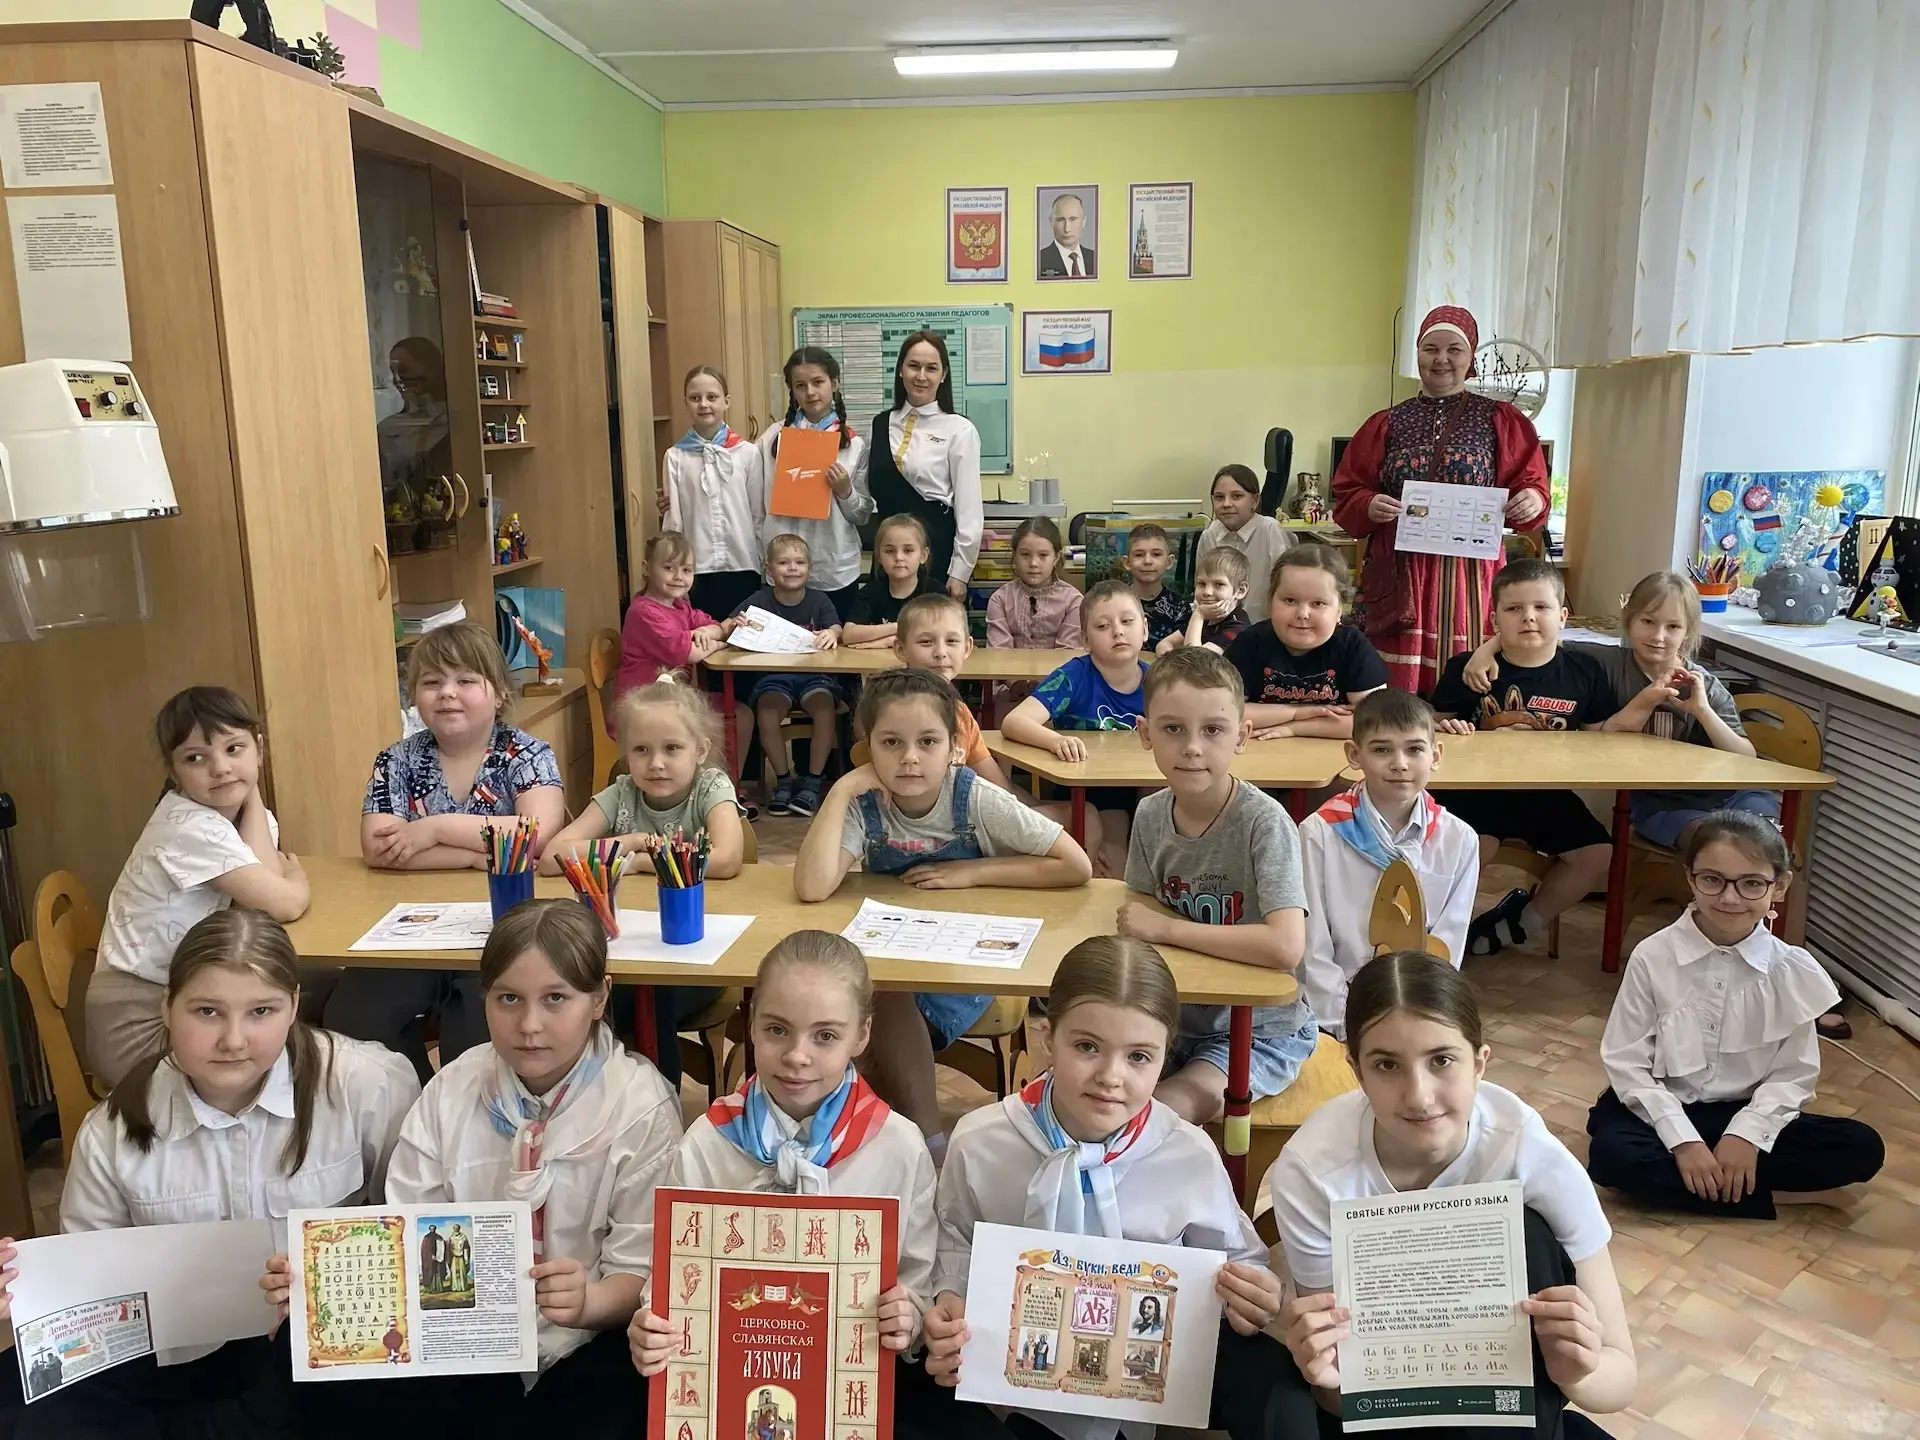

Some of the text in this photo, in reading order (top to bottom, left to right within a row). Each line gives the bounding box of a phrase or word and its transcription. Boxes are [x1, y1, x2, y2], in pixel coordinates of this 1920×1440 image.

[1529, 696, 1576, 712] LABUBU
[1346, 1195, 1508, 1220] СВЯТЫЕ КОРНИ РУССКОГО ЯЗЫКА
[1155, 1268, 1166, 1276] 6+
[1082, 1278, 1094, 1288] 24
[65, 1305, 99, 1319] 24 мая
[1475, 1304, 1509, 1312] ГОВОРИТЬ
[48, 1324, 69, 1338] День
[70, 1309, 118, 1327] славянской
[54, 1317, 114, 1341] письменности
[740, 1317, 810, 1330] ЦЕРКОВНО-
[1389, 1323, 1418, 1331] ЧЕЛОВЕК
[732, 1333, 814, 1346] СЛАВЯНСКАЯ
[743, 1350, 801, 1380] АЗБУКА
